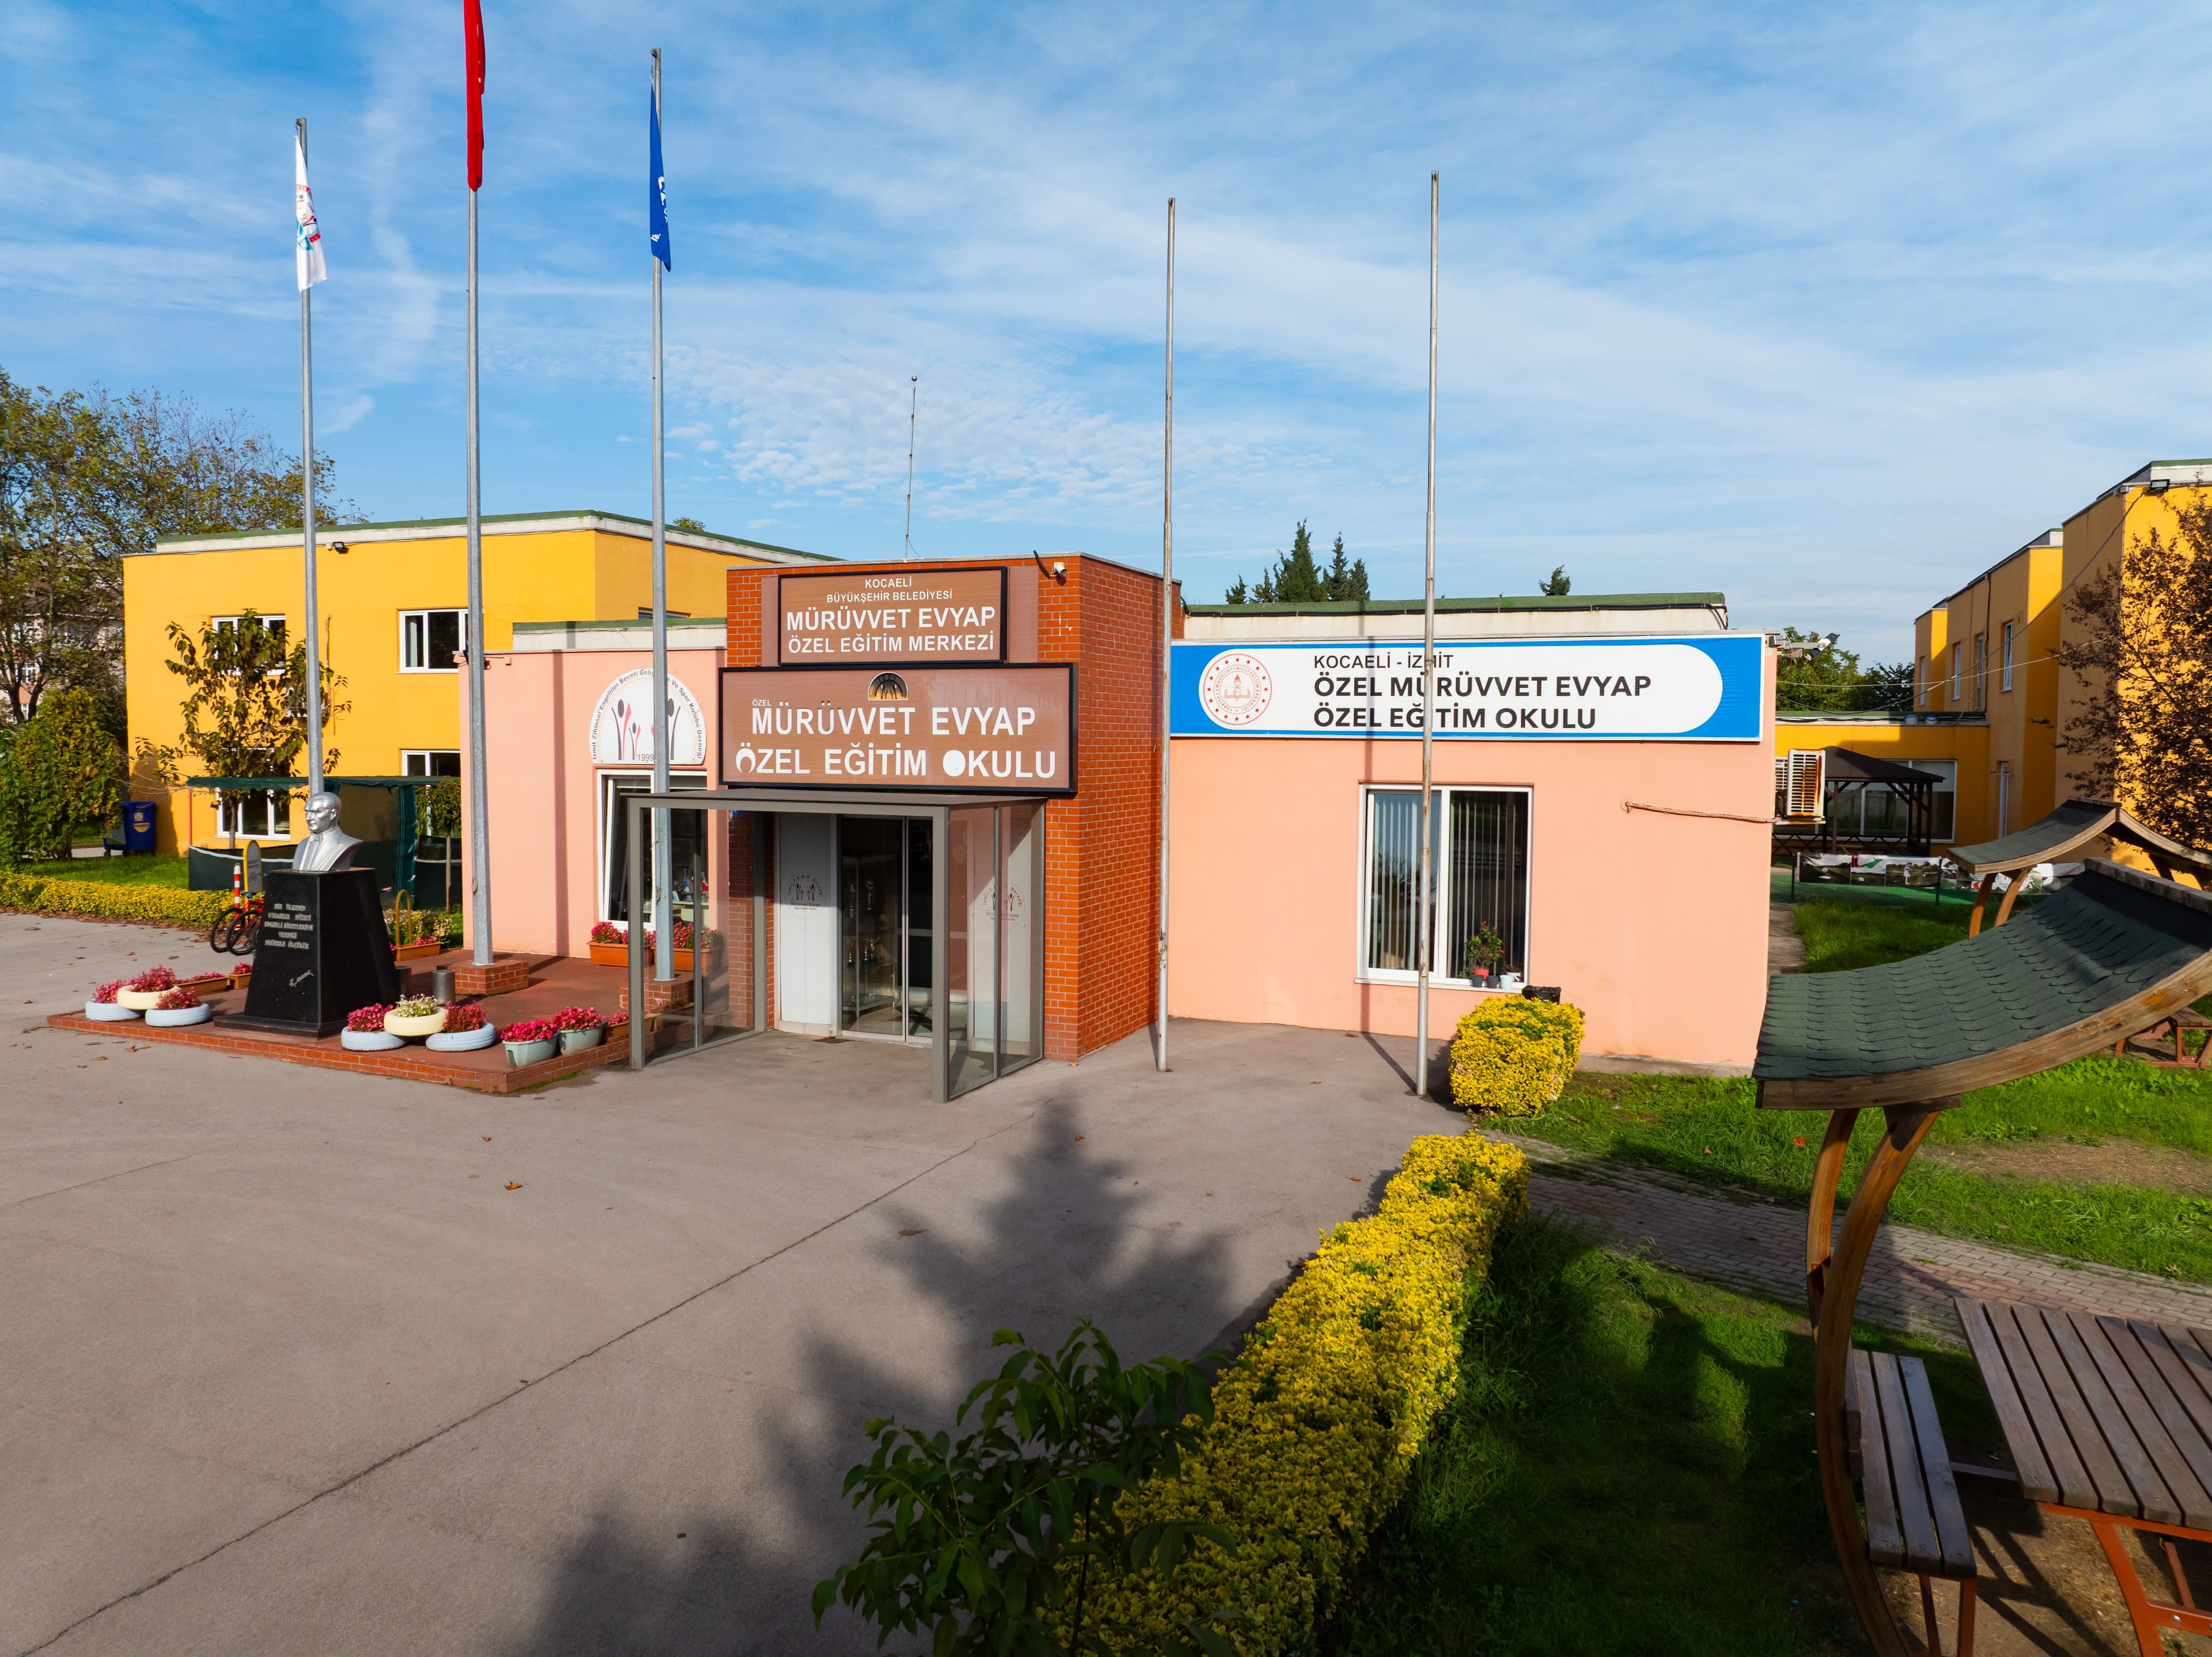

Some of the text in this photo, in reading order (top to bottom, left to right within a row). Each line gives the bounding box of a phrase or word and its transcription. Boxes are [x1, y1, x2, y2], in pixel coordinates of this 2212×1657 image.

[865, 576, 912, 588] KOCAELİ
[827, 588, 952, 604] BÜYÜKŞEHİR BELEDİYESİ
[787, 606, 995, 631] MÜRÜVVET EVYAP
[788, 630, 994, 653] ÖZEL EĞİTİM MERKEZİ
[1314, 652, 1391, 668] KOCAELİ
[679, 687, 691, 702] Spor
[1314, 671, 1382, 697] ÖZEL
[1556, 676, 1651, 696] EVYAP
[752, 698, 772, 706] ÖZEL
[752, 701, 1036, 736] MÜRÜVVET EVYAP
[1314, 702, 1596, 729] ÖZEL EĞTİM OKULU
[735, 742, 1055, 778] ÖZEL EĞİTİM OKULU
